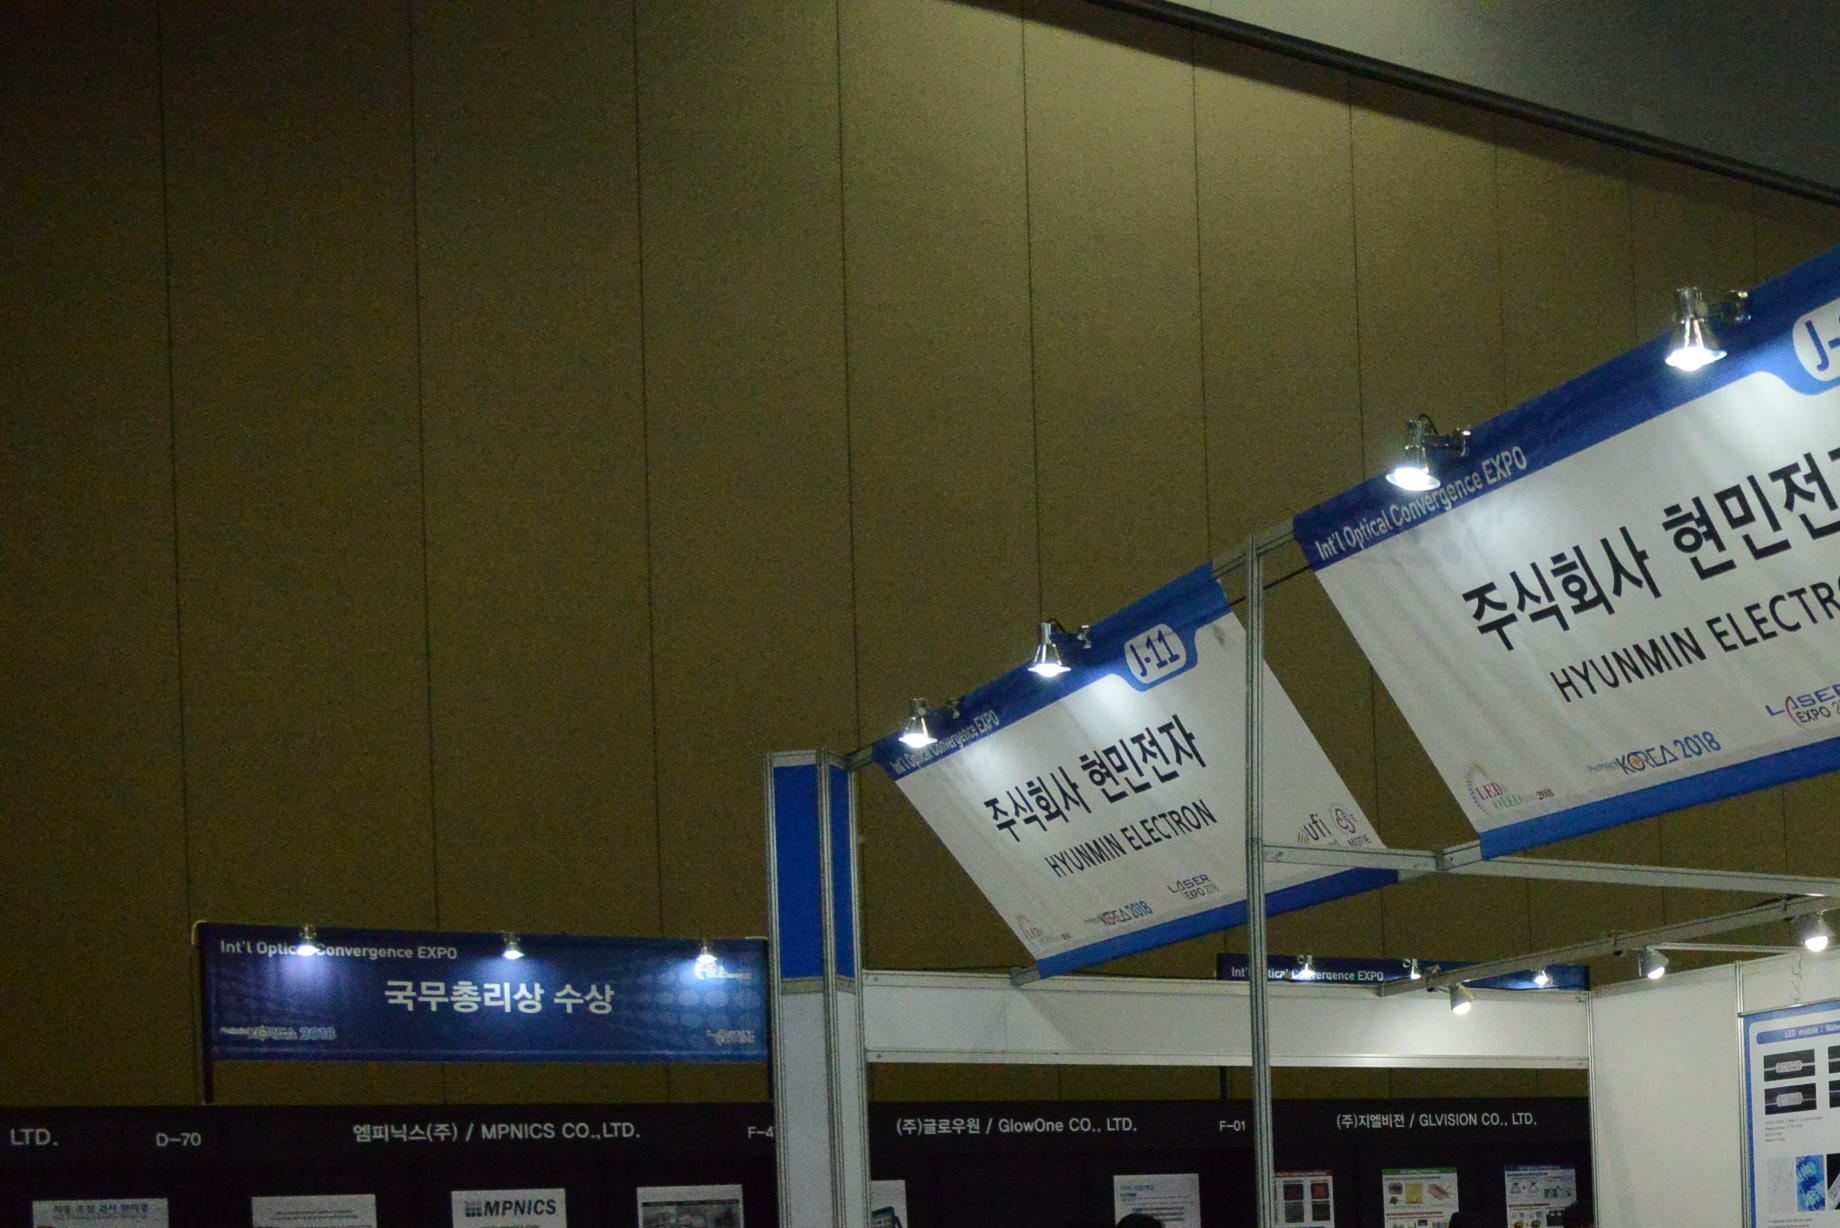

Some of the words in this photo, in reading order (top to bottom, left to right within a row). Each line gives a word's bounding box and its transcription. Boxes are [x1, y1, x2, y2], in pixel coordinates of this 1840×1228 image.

[1315, 531, 1345, 561] Int'l
[1344, 510, 1391, 550] Optical
[1389, 472, 1484, 528] Convergence
[1481, 445, 1528, 485] EXPO
[1462, 526, 1662, 652] 주식회사
[1129, 629, 1181, 678] J-11
[1550, 626, 1707, 703] HYUNMIN
[1795, 705, 1832, 724] EXPO
[1672, 730, 1722, 759] 2018
[983, 766, 1092, 843] 주식회사
[1079, 714, 1207, 804] 현민전자
[1045, 832, 1128, 879] HYUNMIN
[1120, 798, 1218, 852] ELECTRON
[1303, 813, 1333, 841] ufi
[256, 941, 300, 958] Optic
[417, 946, 458, 960] EXPO
[384, 979, 544, 1013] 국무총리상
[553, 983, 615, 1015] 수상
[896, 1118, 981, 1136] (주)글로우원
[998, 1117, 1064, 1133] GlowOne
[1106, 1117, 1138, 1132] LTD.
[1219, 1120, 1246, 1132] F-01
[1418, 1112, 1478, 1128] GLVISION
[1511, 1111, 1538, 1127] LTD.
[10, 1128, 59, 1147] LTD.
[156, 1131, 201, 1147] D-70
[353, 1123, 459, 1143] 엠피닉스(주)
[482, 1123, 556, 1140] MPNICS
[484, 1198, 557, 1217] MPNICS
